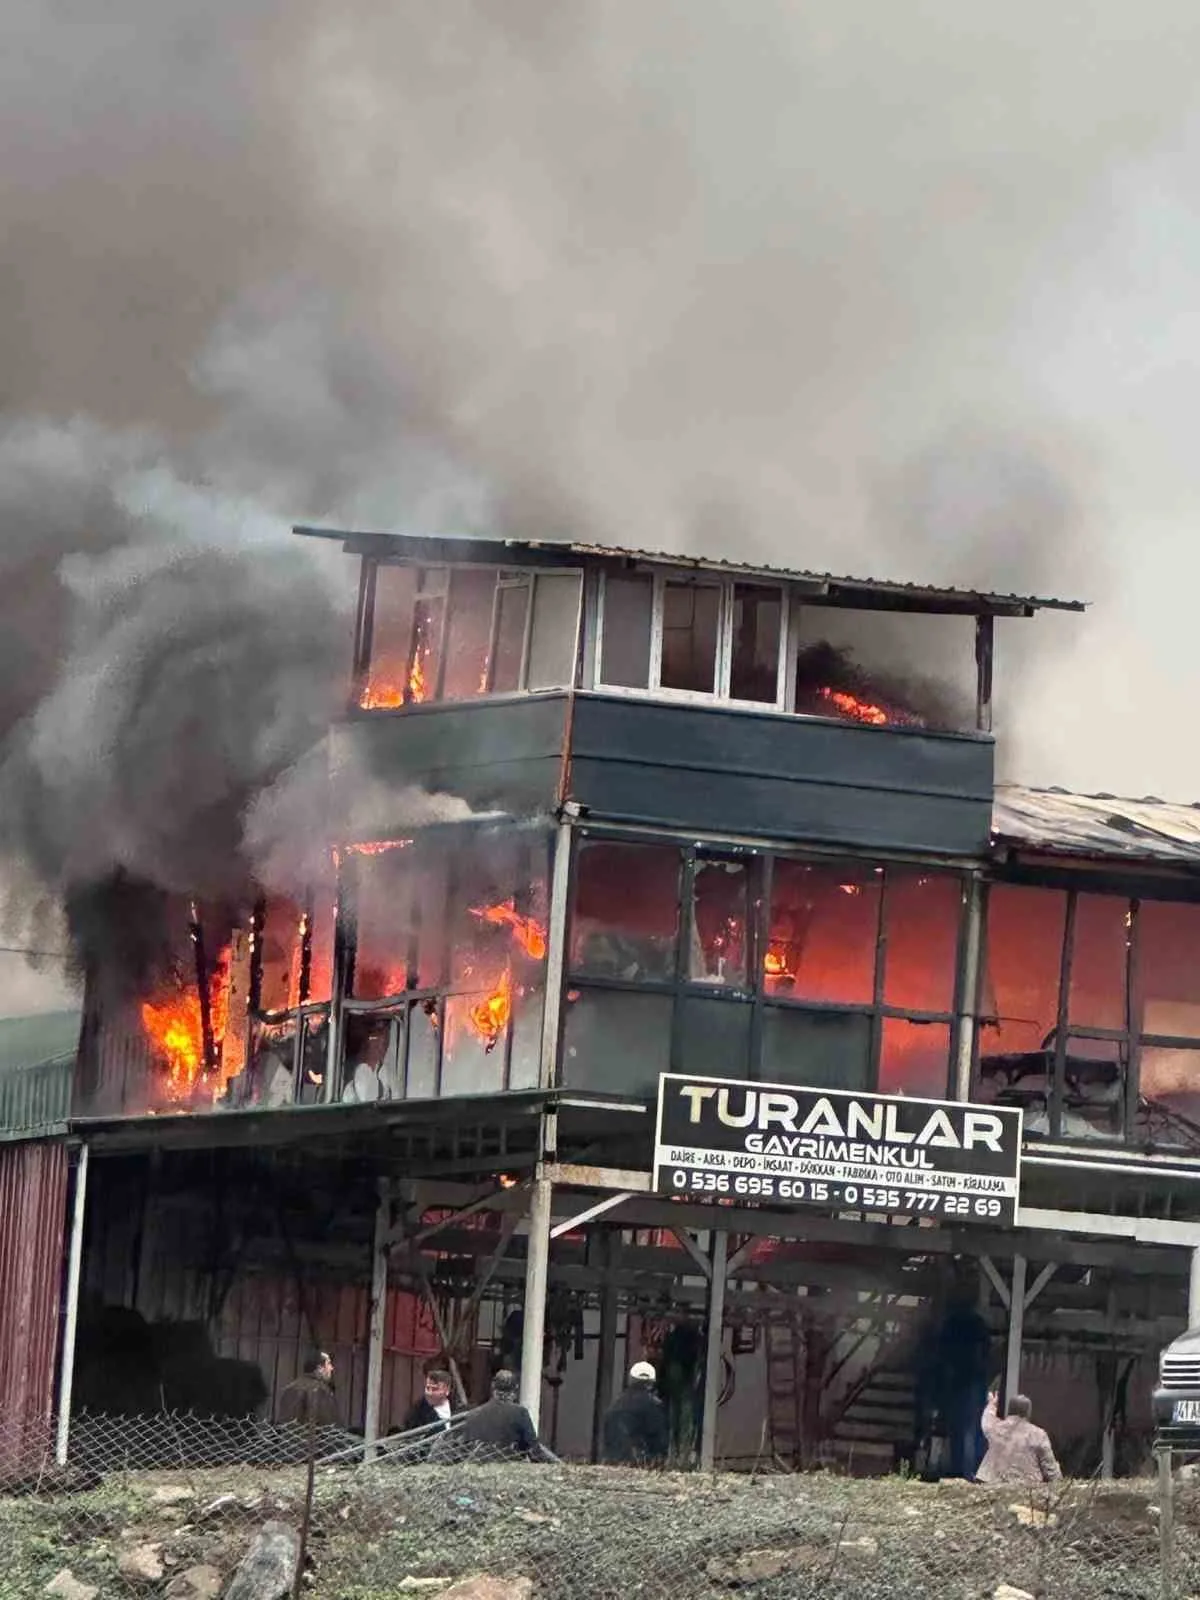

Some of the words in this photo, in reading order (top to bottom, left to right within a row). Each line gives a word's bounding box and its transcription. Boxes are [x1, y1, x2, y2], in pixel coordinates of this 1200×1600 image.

[679, 1085, 1004, 1153] TURANLAR
[703, 1153, 726, 1166] ARSA
[733, 1157, 756, 1169] DEPO
[885, 1171, 903, 1183] OTO
[903, 1172, 924, 1185] ALIM
[744, 1133, 935, 1169] GAYRİMENKUL
[673, 1170, 687, 1188] 0
[691, 1172, 730, 1192] 536
[734, 1177, 774, 1196] 695
[778, 1181, 805, 1198] 60
[810, 1183, 829, 1200] 15
[844, 1186, 858, 1204] 0
[862, 1188, 900, 1207] 535
[904, 1191, 941, 1211] 777
[943, 1196, 970, 1215] 22
[974, 1198, 1001, 1217] 69
